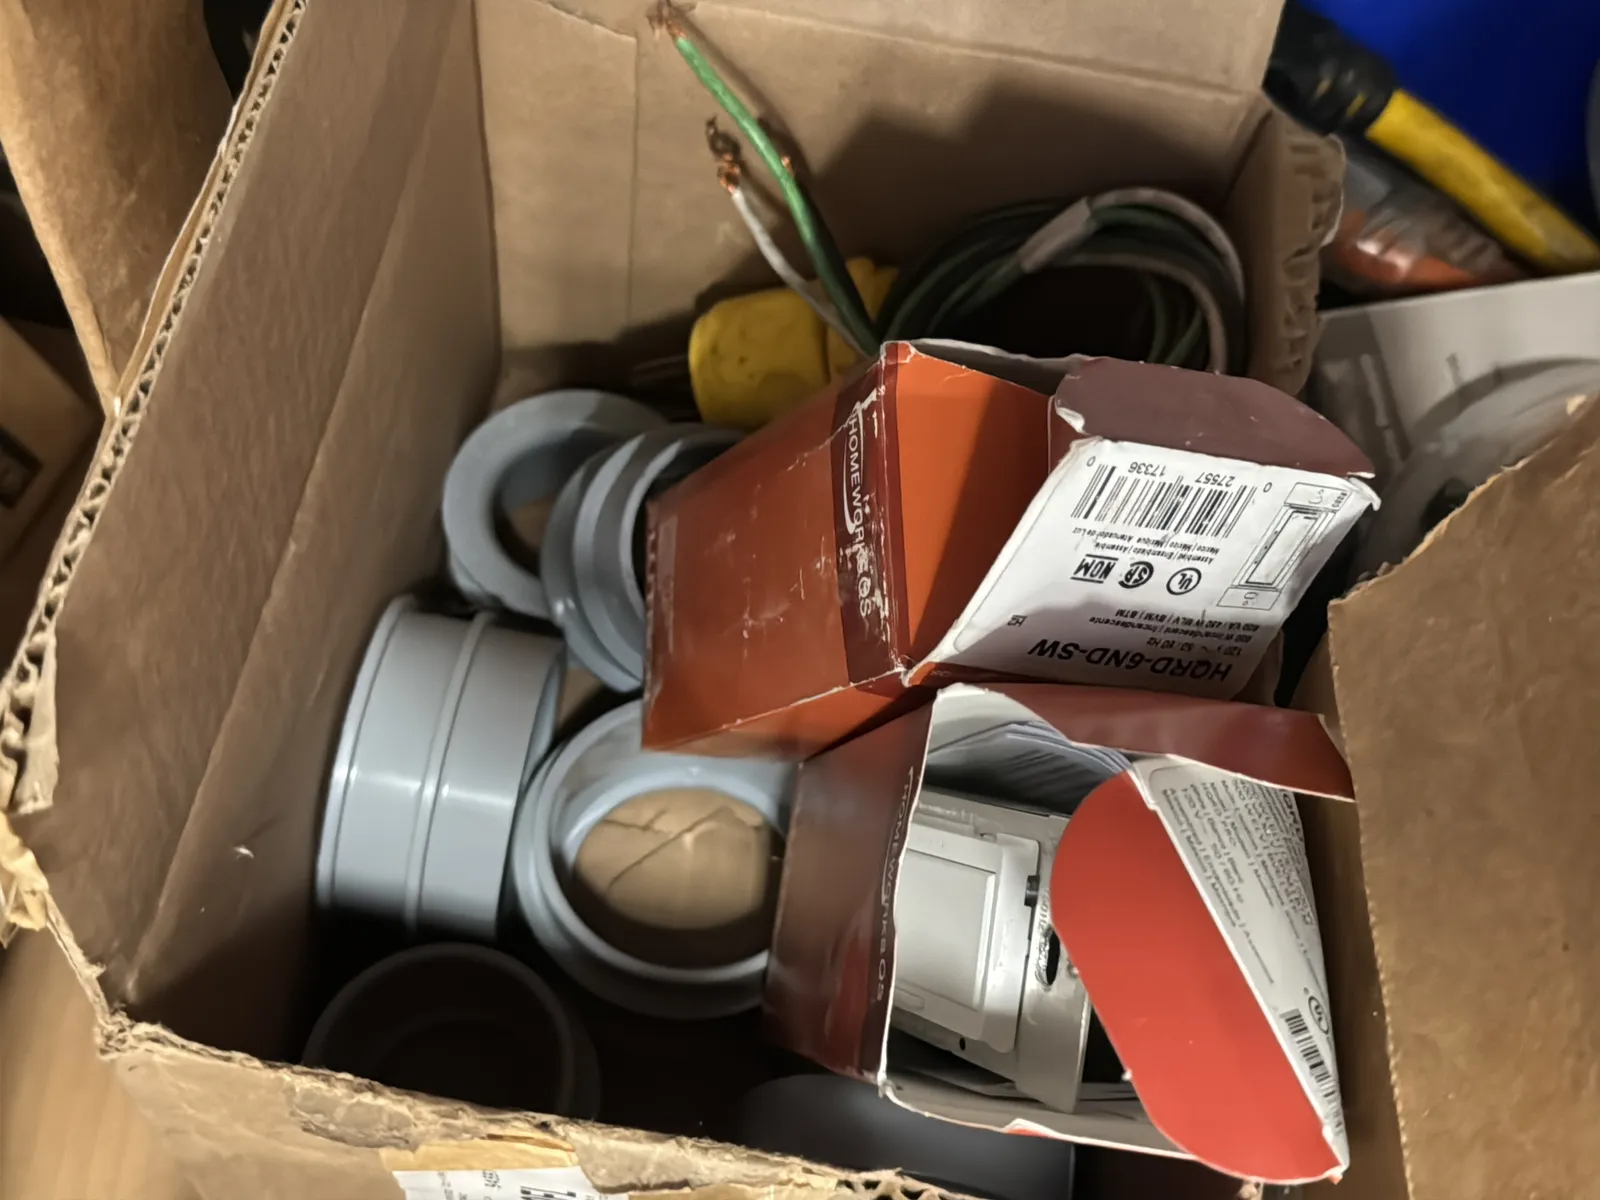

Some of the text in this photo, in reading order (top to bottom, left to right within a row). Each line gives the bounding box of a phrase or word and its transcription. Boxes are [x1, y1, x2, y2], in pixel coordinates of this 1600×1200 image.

[1086, 456, 1272, 492] 0 27557 17336 0
[1073, 556, 1117, 581] NOM
[1089, 616, 1157, 632] Incandescente
[1115, 608, 1138, 620] BTM
[1027, 638, 1232, 682] HQRD-6ND-SW
